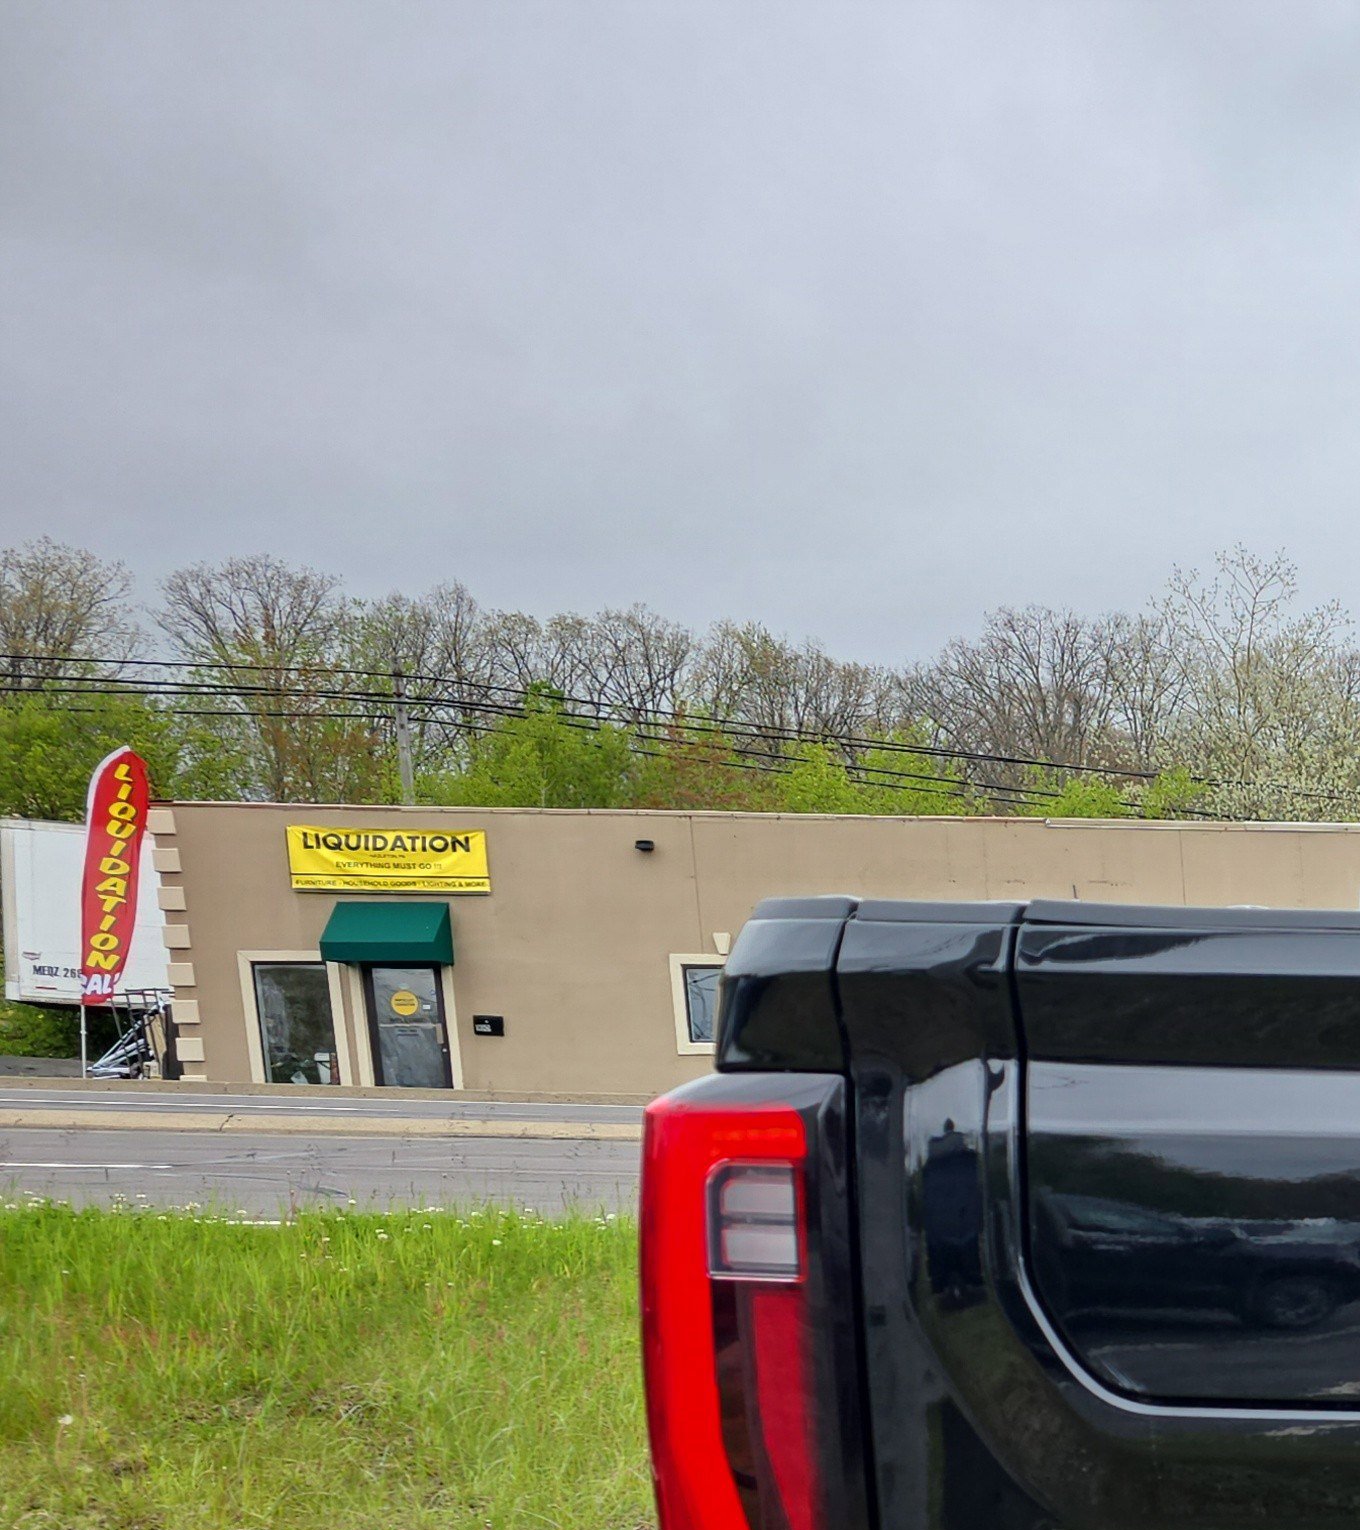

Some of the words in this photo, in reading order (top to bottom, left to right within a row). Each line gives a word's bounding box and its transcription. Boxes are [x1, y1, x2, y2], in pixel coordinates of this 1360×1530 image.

[302, 831, 471, 853] LIQUIDATION
[86, 763, 137, 971] LIQUIDATION
[335, 861, 391, 870] EVERYTHING
[392, 862, 417, 870] MUST
[295, 879, 337, 887] FURNITURE
